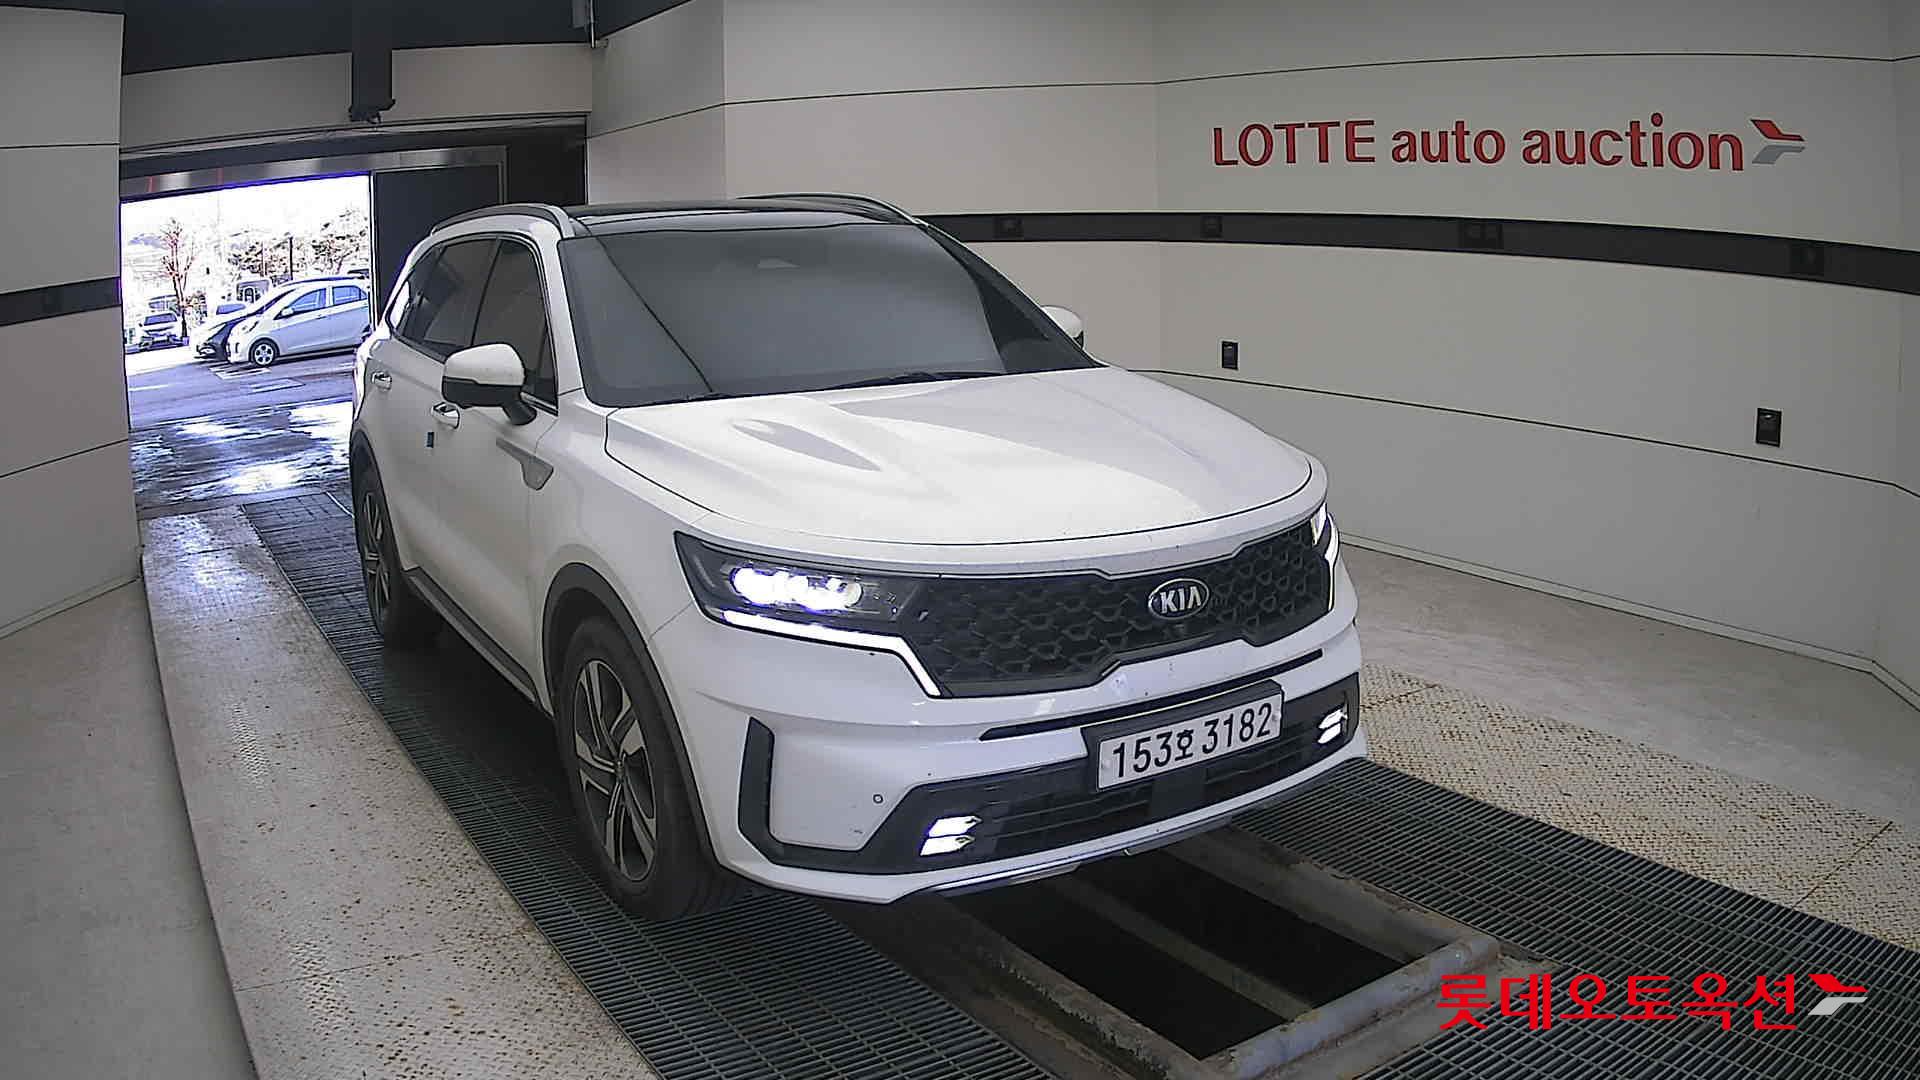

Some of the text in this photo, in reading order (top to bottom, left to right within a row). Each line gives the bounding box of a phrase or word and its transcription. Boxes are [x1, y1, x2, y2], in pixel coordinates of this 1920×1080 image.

[1213, 112, 1744, 171] LOTTE auto auction
[1160, 586, 1201, 613] KIA
[1113, 702, 1272, 778] 153호 3182
